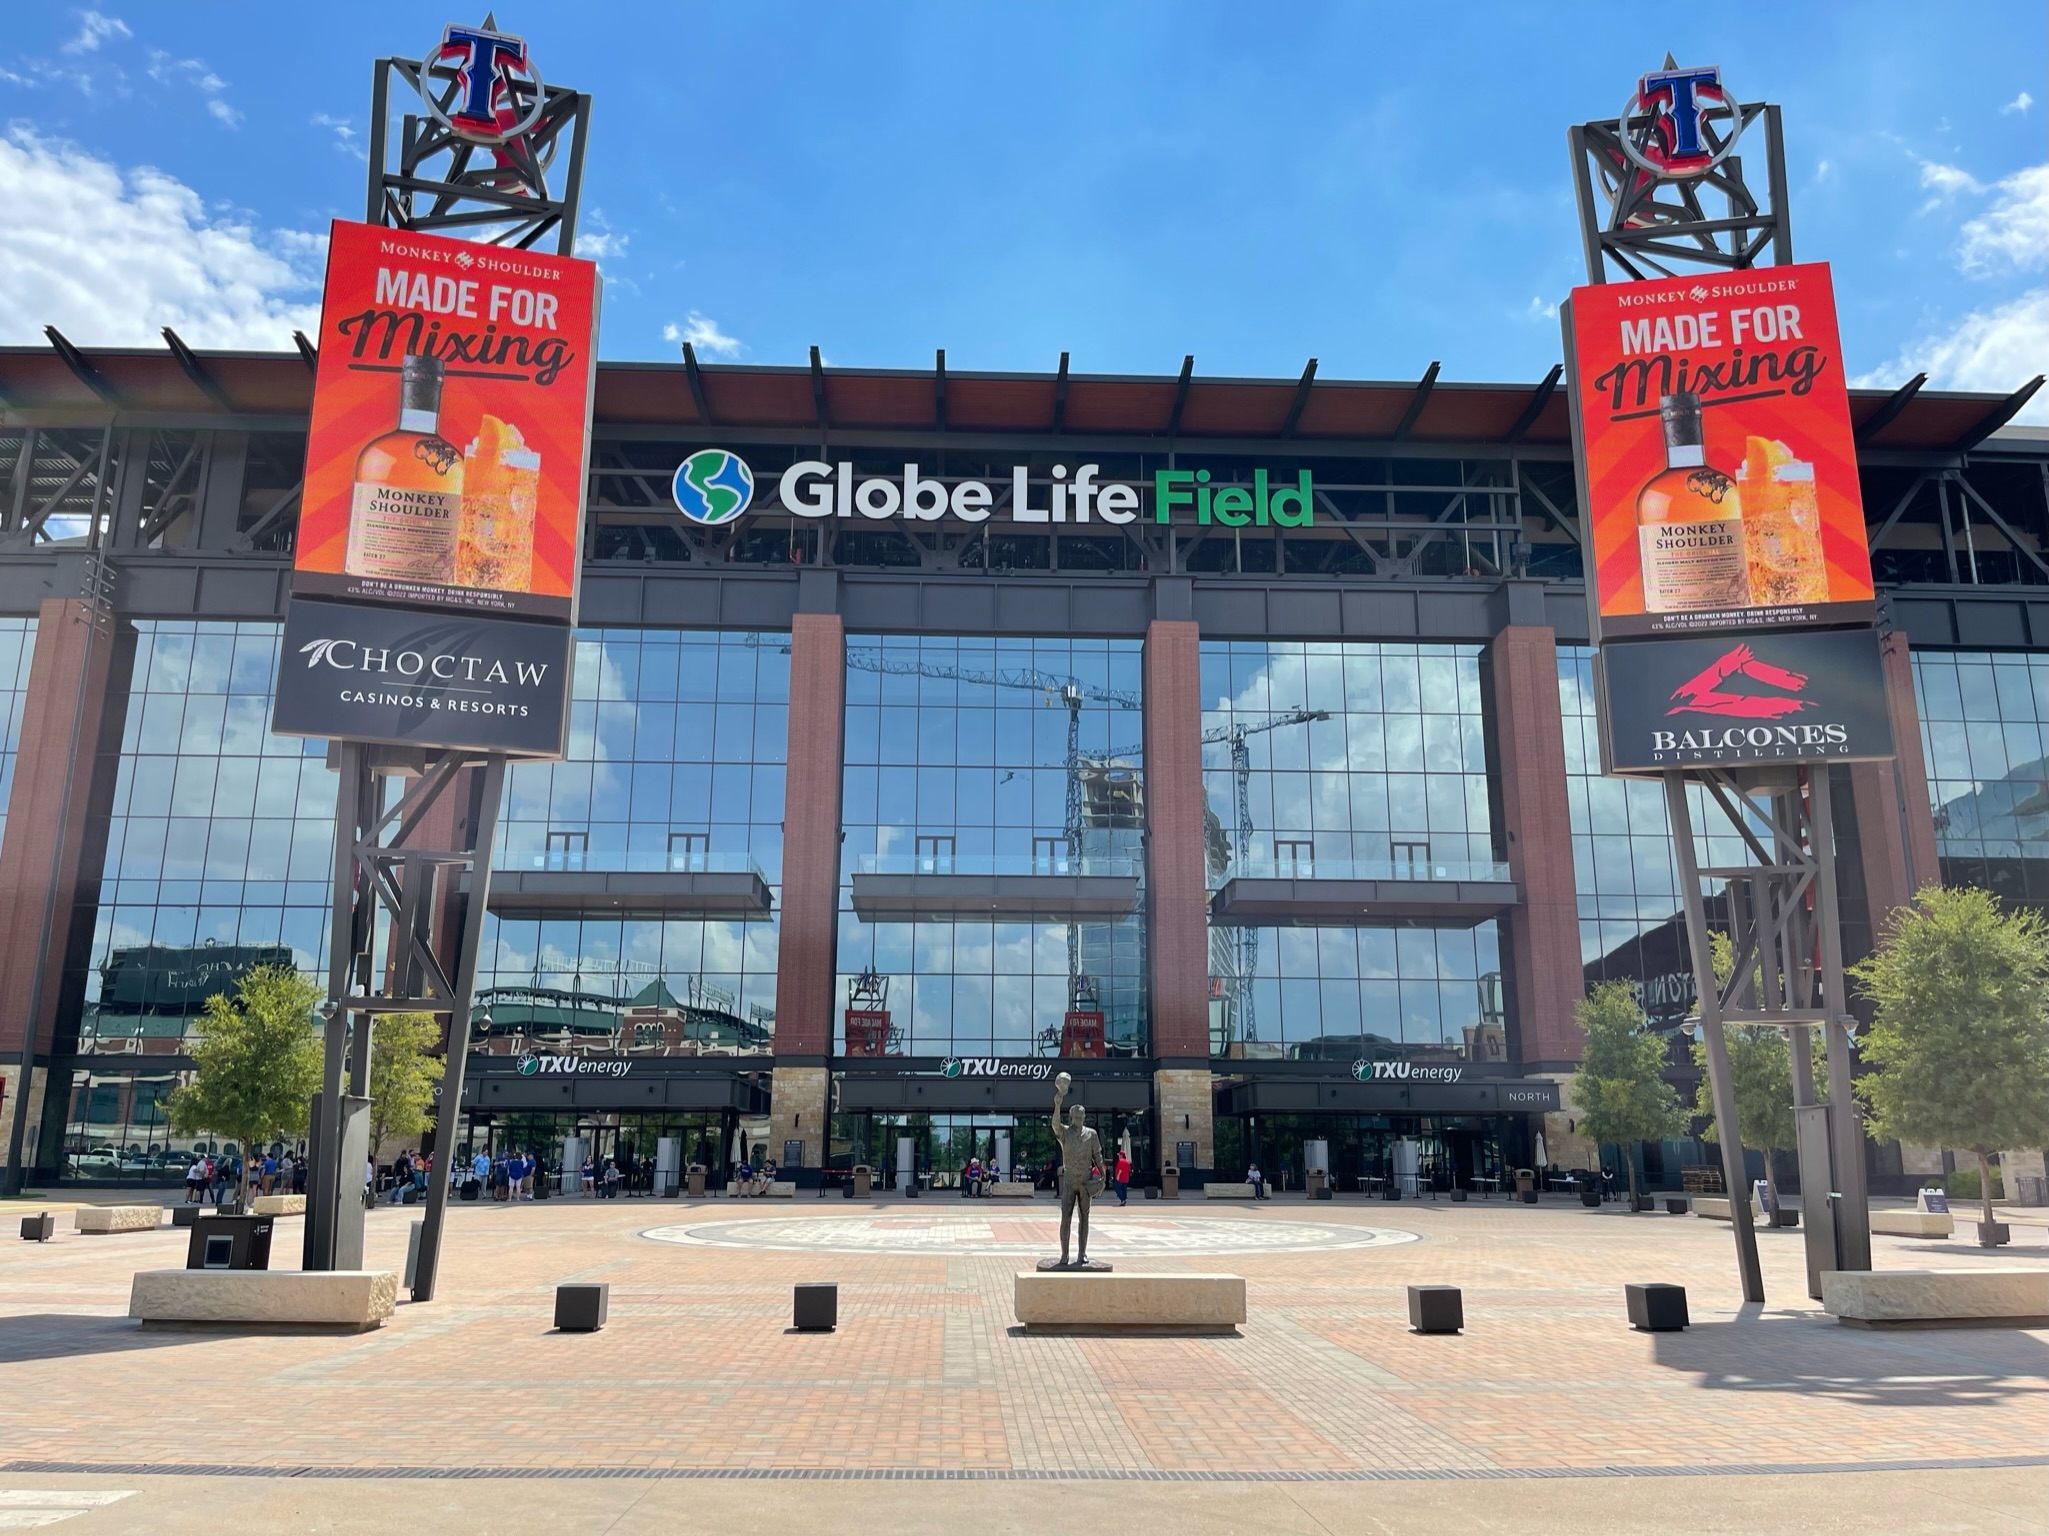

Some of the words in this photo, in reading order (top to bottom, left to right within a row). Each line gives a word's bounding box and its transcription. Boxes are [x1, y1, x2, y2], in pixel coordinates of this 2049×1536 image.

[380, 240, 452, 263] MONKEY
[477, 257, 561, 281] SHOULDER
[375, 267, 478, 319] MADE
[489, 285, 559, 330] FOR
[1618, 290, 1686, 307] MONKEY
[1711, 279, 1797, 298] SHOULDER
[1620, 312, 1721, 356] MADE
[1730, 304, 1803, 345] FOR
[337, 309, 575, 386] Mixing
[1594, 345, 1827, 409] Mixing
[377, 487, 446, 506] MONKEY
[779, 460, 993, 522] Globe
[1012, 463, 1139, 525] Life
[1155, 468, 1313, 528] Field
[369, 499, 450, 520] SHOULDER
[1656, 535, 1734, 549] SHOULDER
[1661, 523, 1726, 537] MONKEY
[325, 639, 549, 687] CHOCTAW
[340, 690, 424, 708] CASINOS
[430, 698, 441, 710] &
[448, 700, 529, 717] RESORTS
[1651, 722, 1848, 751] BALCONES
[1653, 744, 1849, 761] DISTILLING
[539, 1056, 579, 1073] TXU
[579, 1061, 632, 1077] energy
[961, 1058, 1000, 1075] TXU
[1000, 1064, 1052, 1079] energy
[1372, 1062, 1410, 1079] TXU
[1411, 1067, 1462, 1083] energy
[1509, 1092, 1549, 1101] NORTH
